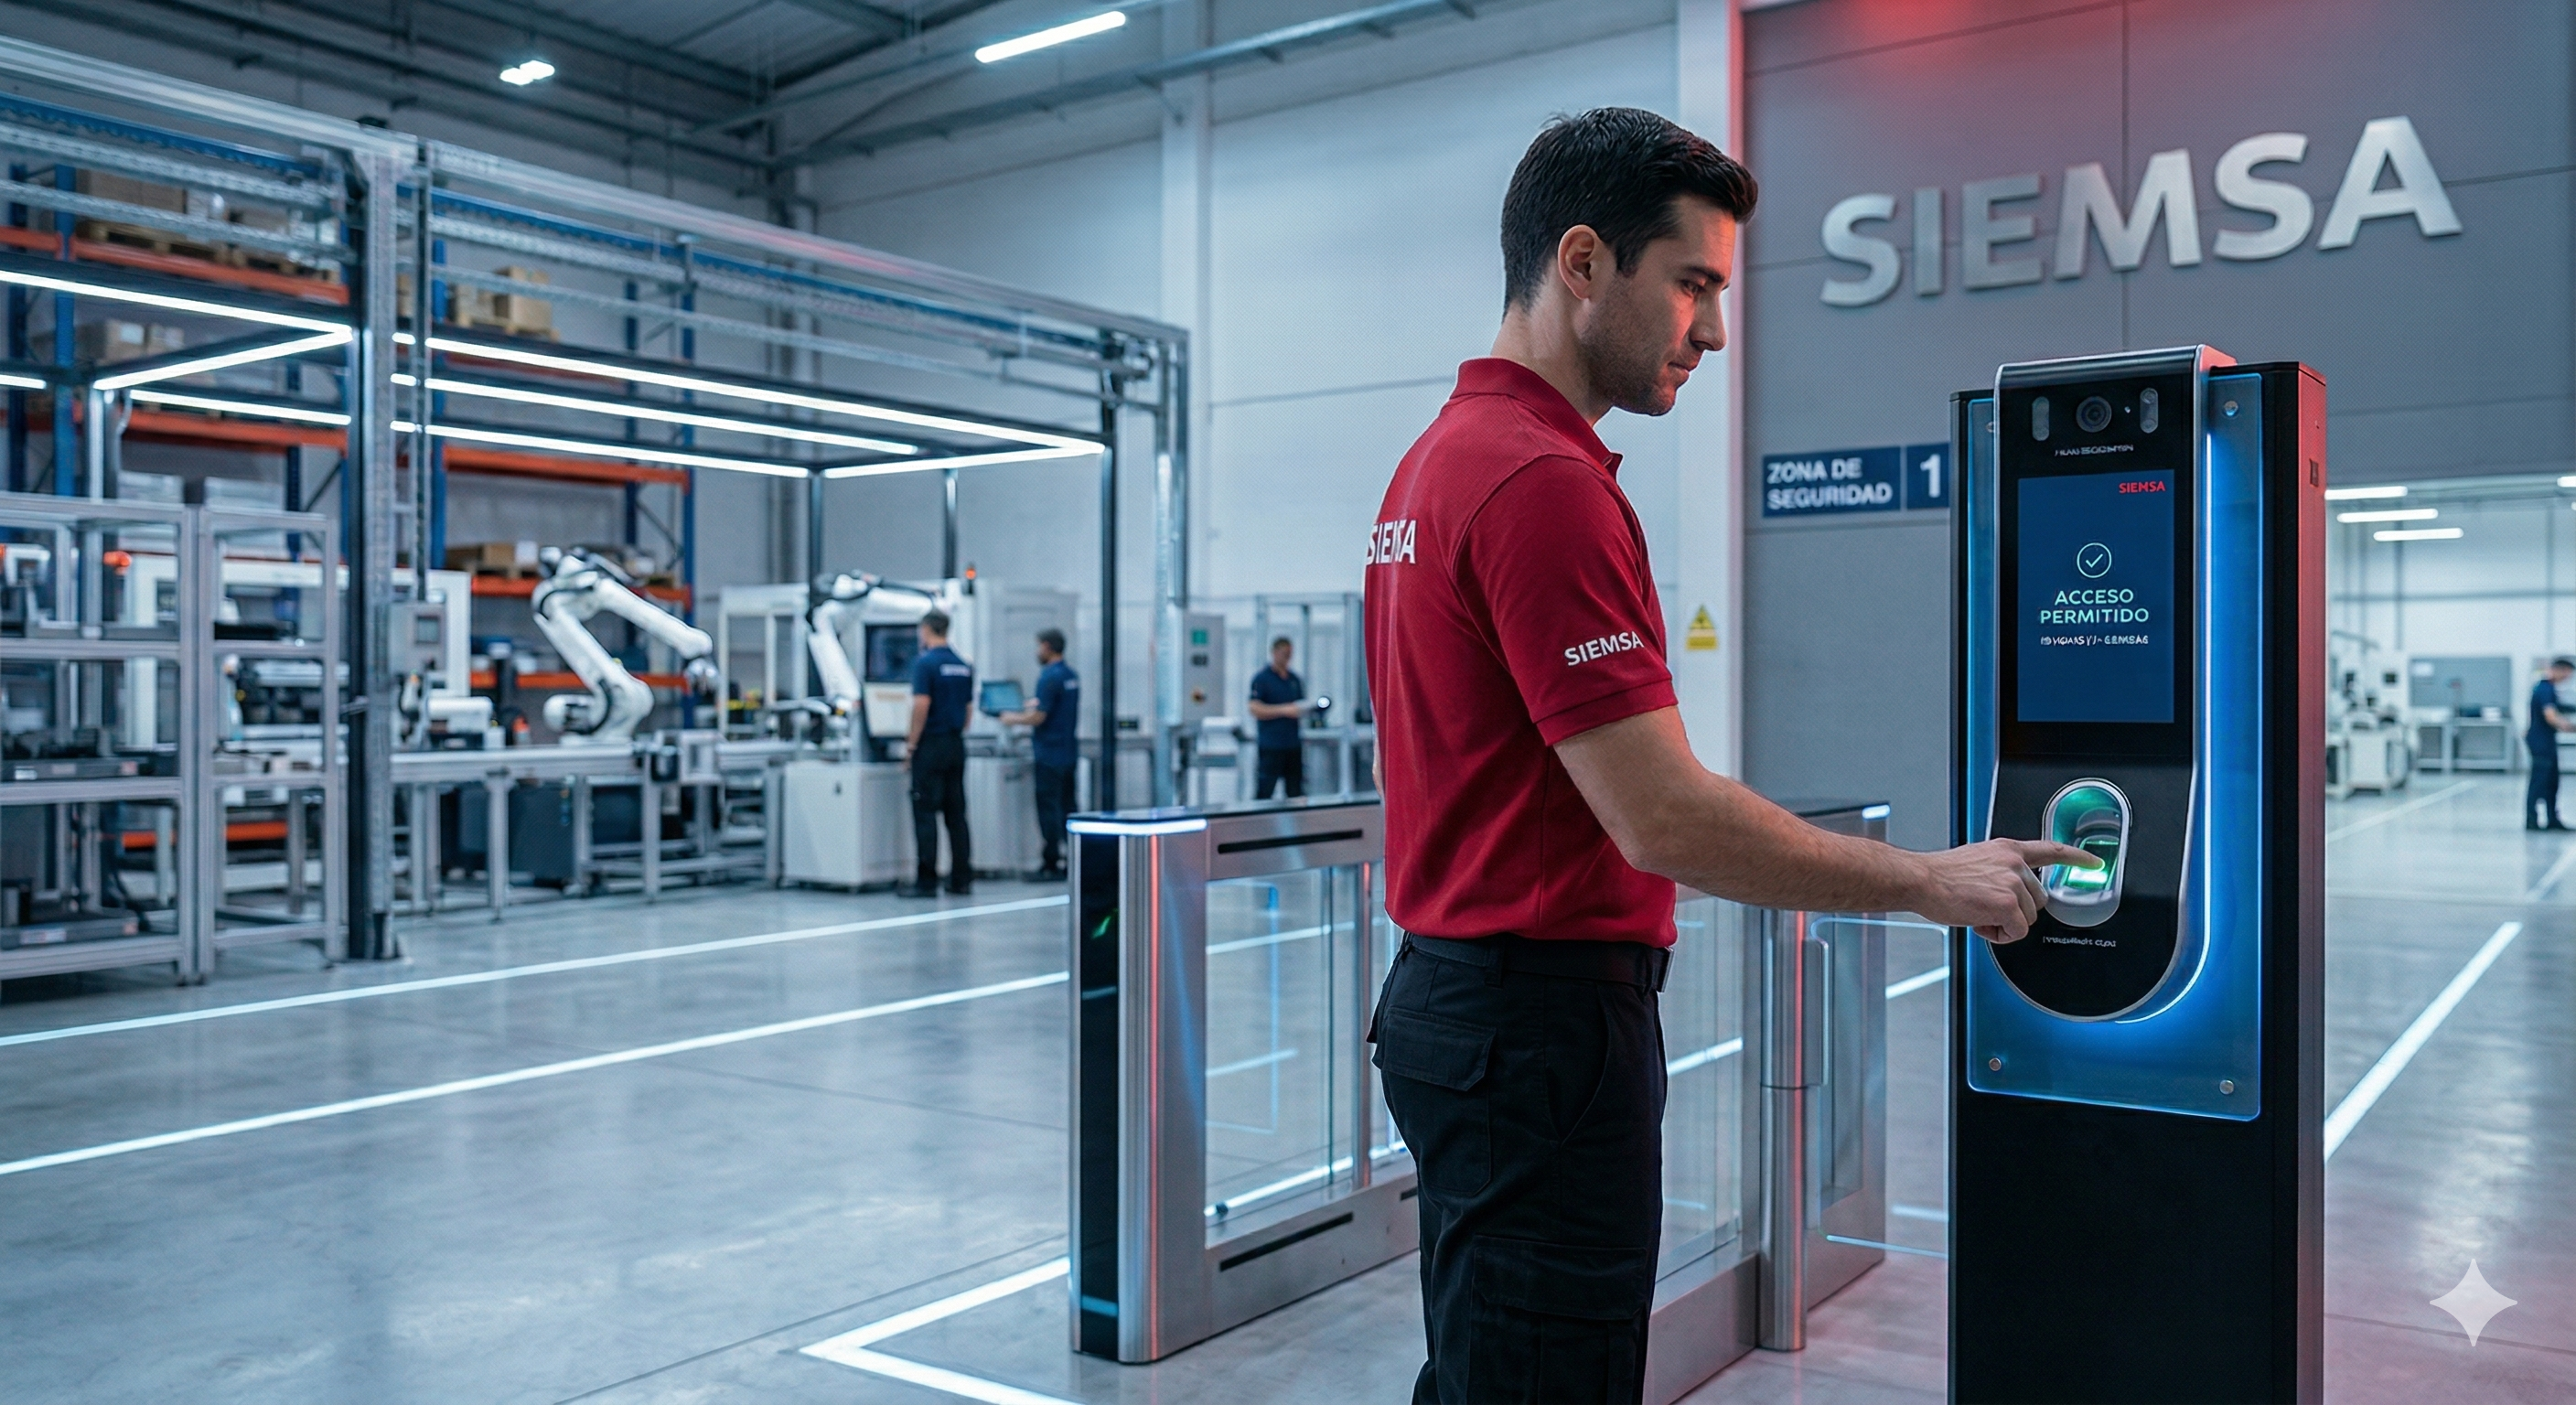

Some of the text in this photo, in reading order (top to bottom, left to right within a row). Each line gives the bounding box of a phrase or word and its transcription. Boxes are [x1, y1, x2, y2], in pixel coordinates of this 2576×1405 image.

[1819, 115, 2463, 306] SIEMSA
[1766, 457, 1862, 485] ZONA DE
[1919, 454, 1941, 499] 1
[1766, 481, 1894, 510] SEGURIDAD
[2119, 481, 2165, 493] SIEMSA
[2055, 589, 2134, 605] ACCESO
[2041, 608, 2149, 624] PERMITIDO
[1564, 630, 1644, 666] SIEMSA
